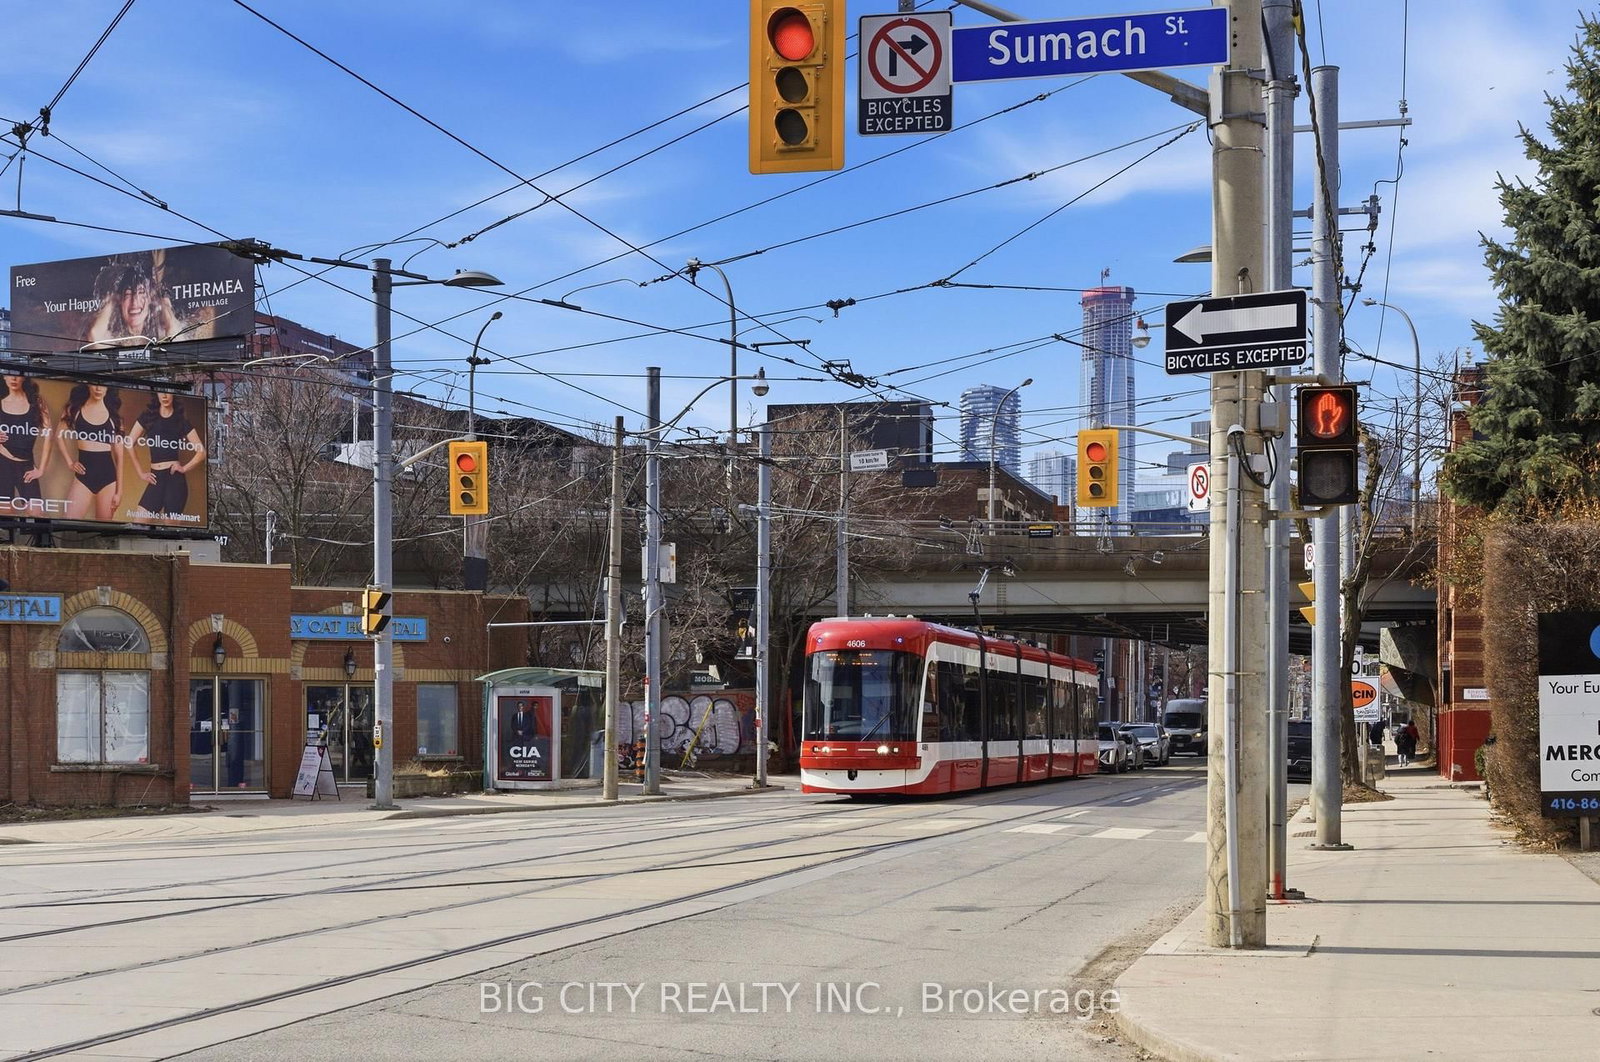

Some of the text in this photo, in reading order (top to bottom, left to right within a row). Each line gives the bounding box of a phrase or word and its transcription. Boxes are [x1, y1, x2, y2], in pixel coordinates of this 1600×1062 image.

[989, 20, 1146, 66] Sumach
[868, 99, 941, 115] BICYCLES
[866, 116, 944, 131] EXCEPTED
[16, 275, 36, 288] Free
[172, 279, 244, 300] THERMEA
[44, 298, 101, 313] Your Happy
[188, 298, 229, 309] SPA VILLAGE
[1167, 346, 1305, 370] BICYCLES EXCEPTED
[58, 429, 133, 449] smoothing
[137, 435, 203, 452] collection
[0, 496, 73, 513] ECRET
[169, 512, 200, 522] Walmart
[308, 620, 341, 633] CAT
[846, 640, 866, 648] 4606
[1548, 681, 1579, 695] Your
[509, 746, 541, 758] CIA
